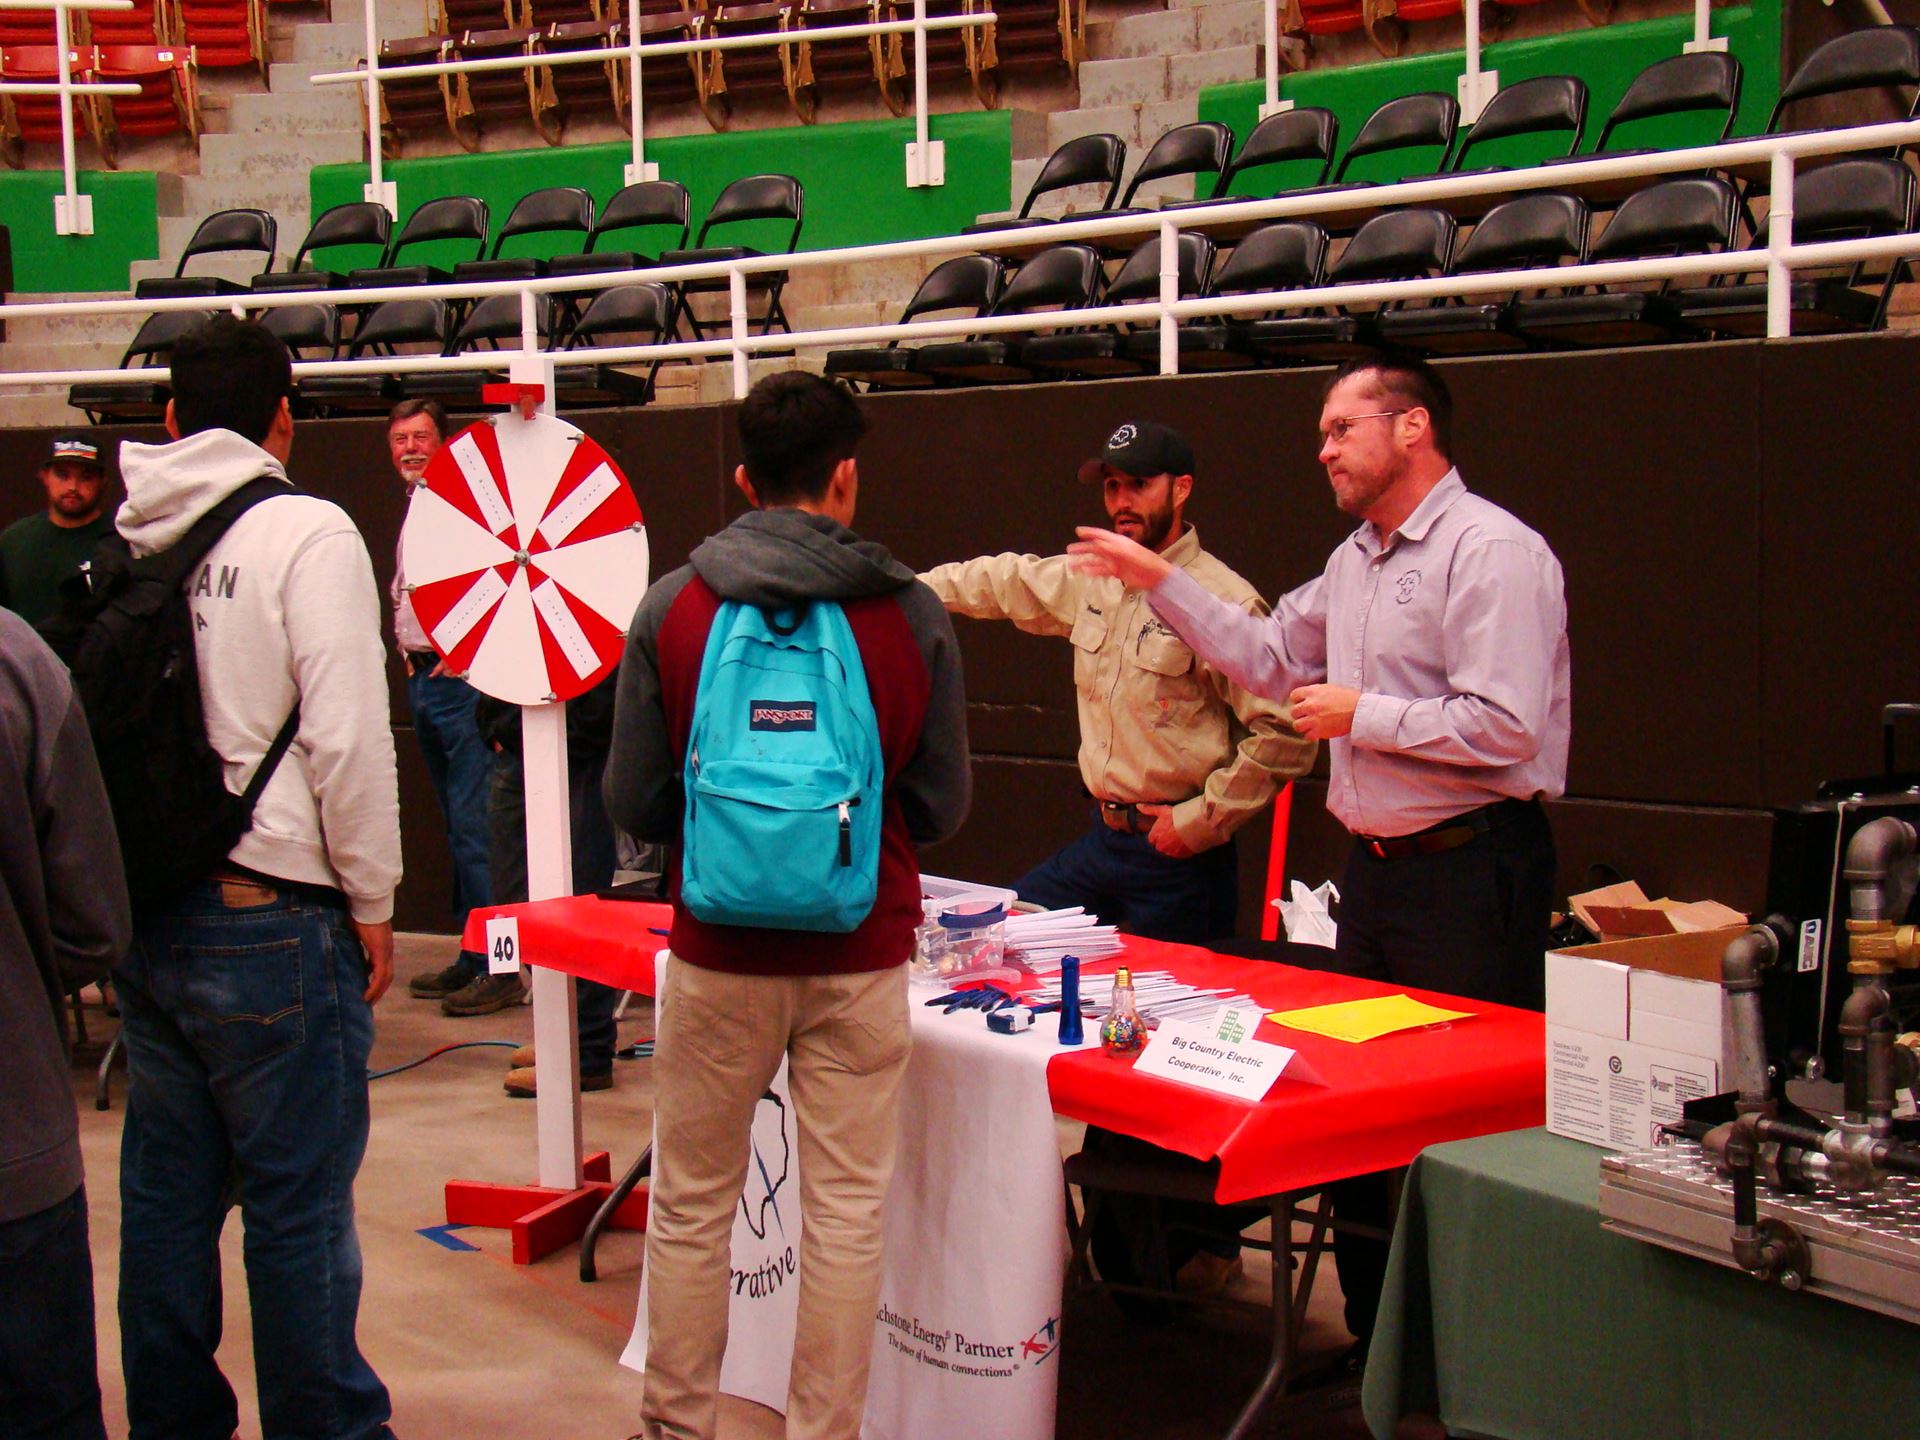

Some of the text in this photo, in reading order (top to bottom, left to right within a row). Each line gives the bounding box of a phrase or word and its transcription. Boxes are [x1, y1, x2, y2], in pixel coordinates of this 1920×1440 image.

[185, 563, 240, 599] AN
[752, 708, 814, 725] JANSPORT
[494, 936, 514, 961] 40
[1172, 1036, 1264, 1068] Big Country Electric
[1228, 1071, 1246, 1084] Inc.
[730, 1246, 796, 1298] rative
[888, 1332, 899, 1348] The
[899, 1342, 915, 1357] power
[916, 1349, 923, 1362] of
[923, 1350, 949, 1370] human
[954, 1332, 1015, 1358] Partner
